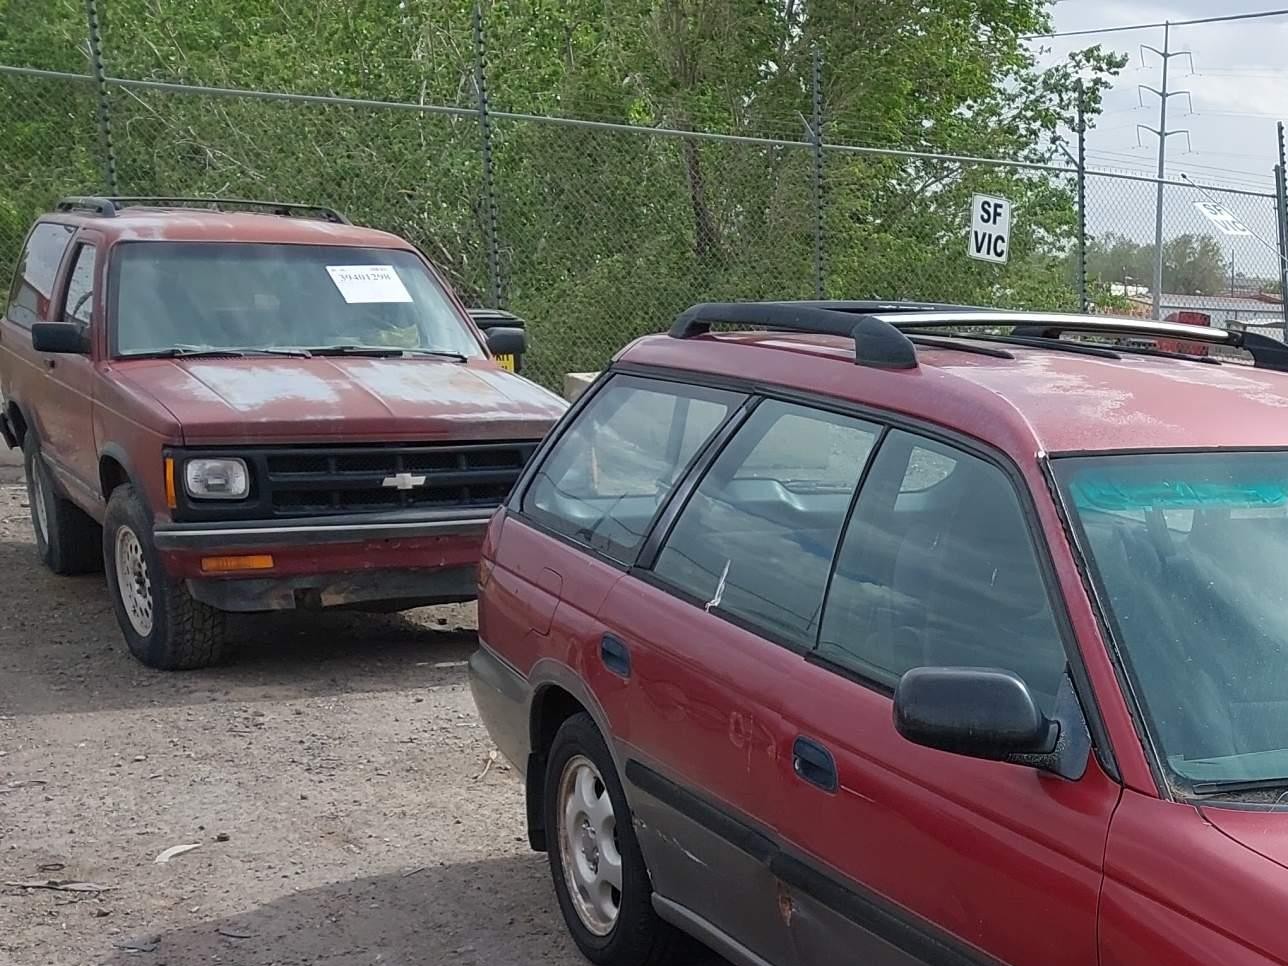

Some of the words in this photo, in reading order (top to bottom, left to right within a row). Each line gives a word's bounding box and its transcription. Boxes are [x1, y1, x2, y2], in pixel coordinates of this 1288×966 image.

[980, 200, 1004, 226] SF
[1203, 203, 1224, 216] SF
[973, 230, 1006, 258] VIC
